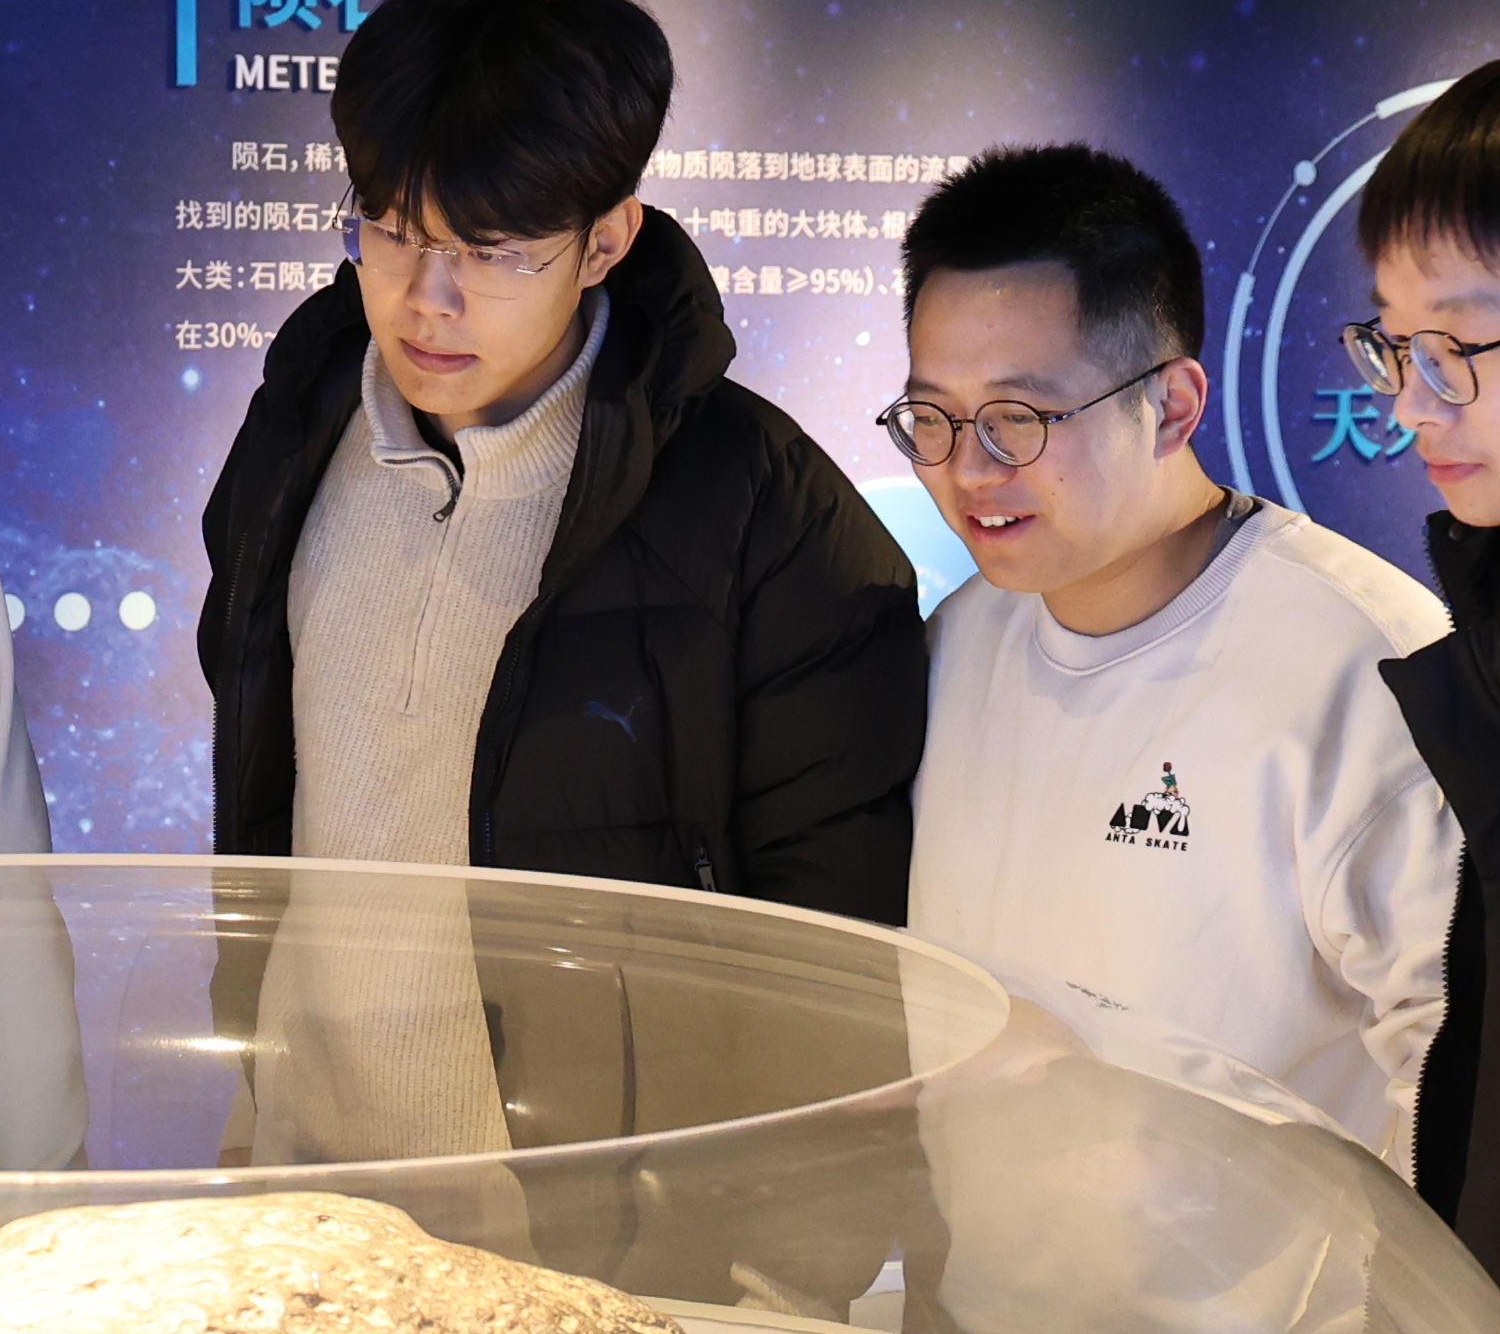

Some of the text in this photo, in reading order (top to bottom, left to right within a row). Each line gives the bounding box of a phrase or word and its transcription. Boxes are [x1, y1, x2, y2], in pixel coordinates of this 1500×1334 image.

[662, 206, 916, 240] 十吨重的大块体。根
[1105, 832, 1189, 852] ANTA SKATE
